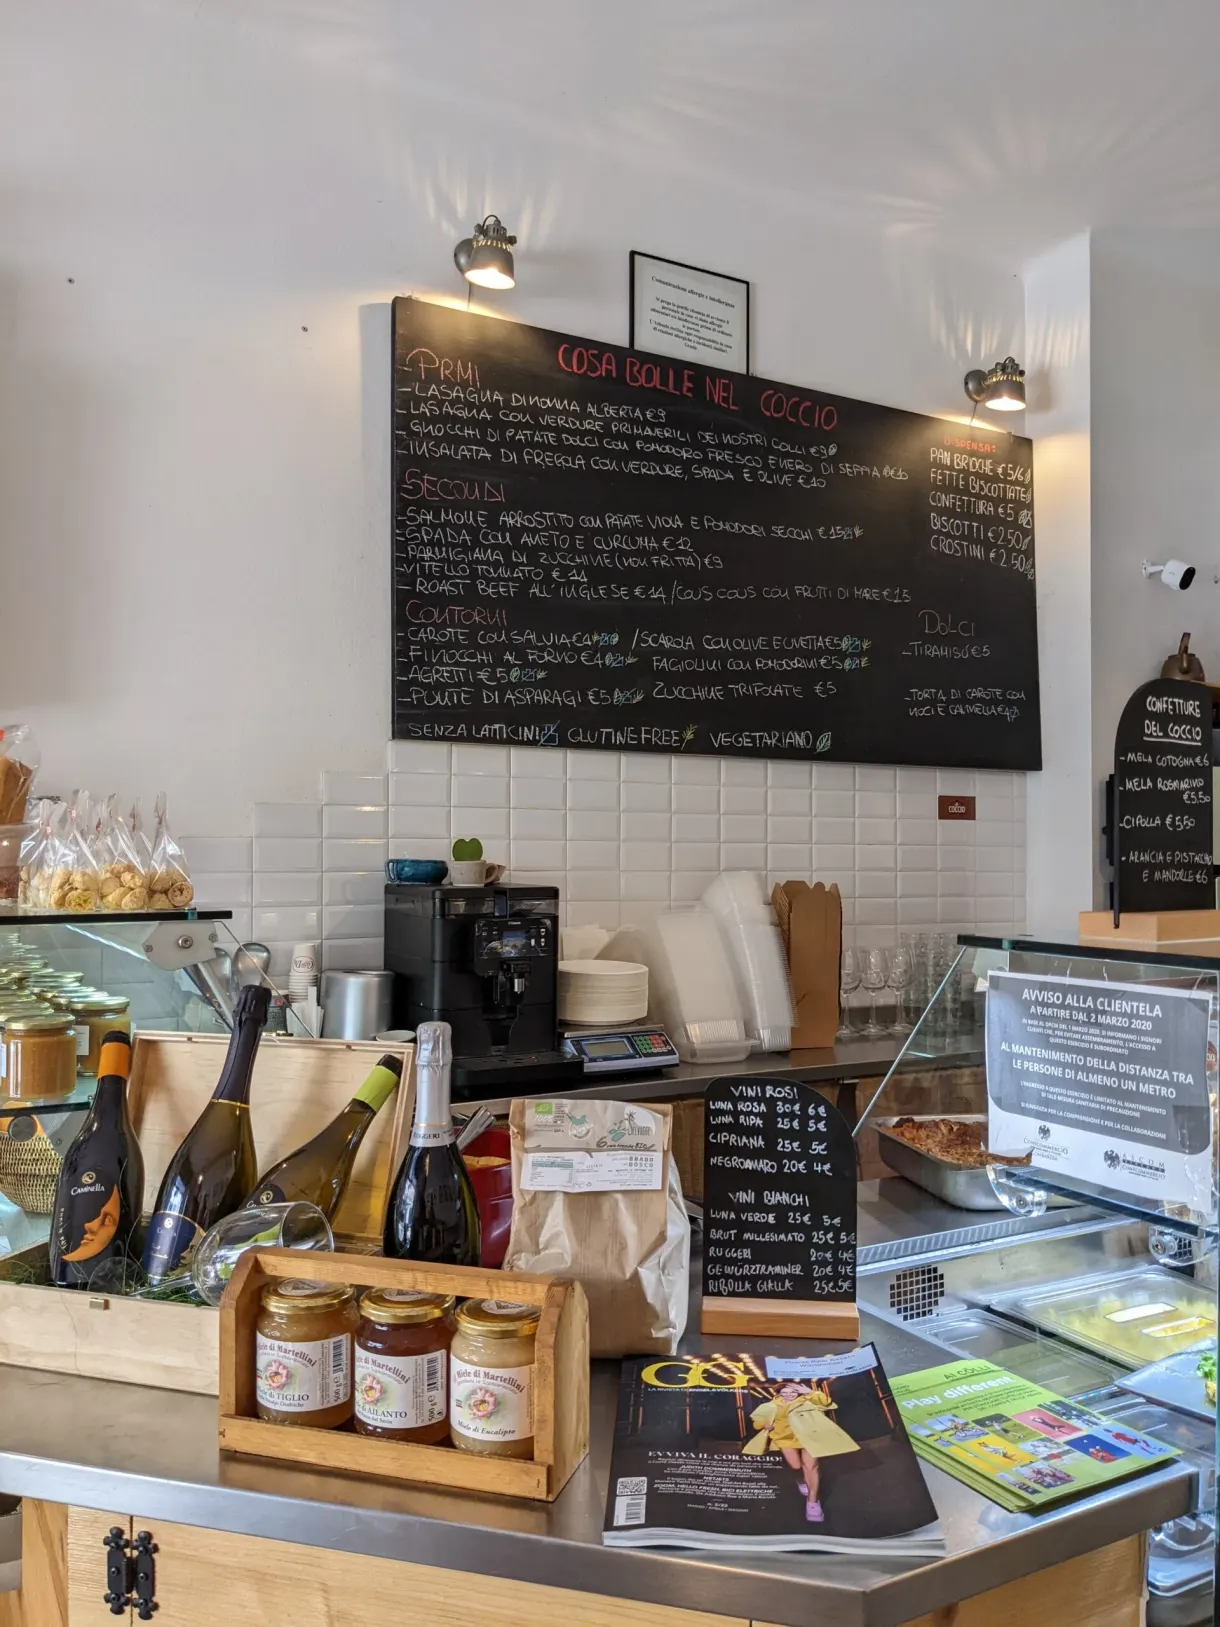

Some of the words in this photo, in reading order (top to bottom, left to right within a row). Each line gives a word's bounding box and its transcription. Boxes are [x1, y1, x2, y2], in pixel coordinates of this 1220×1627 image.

[558, 344, 616, 378] COSA
[626, 358, 694, 397] BOLLE
[706, 379, 739, 410] NEL
[760, 390, 837, 431] COCCIO
[586, 401, 643, 421] ALBERTA
[539, 415, 604, 433] VERDURE
[723, 431, 767, 448] NOSTRI
[771, 438, 805, 456] COLLI
[943, 436, 996, 454] DISPENSA:
[409, 419, 480, 440] GNOCCHI
[506, 429, 557, 447] PATATE
[563, 432, 599, 448] DOLCI
[636, 440, 703, 462] POMODORO
[707, 449, 763, 468] FRESCO
[839, 463, 881, 479] SEPPIA
[410, 441, 492, 462] INSALATA
[691, 464, 735, 482] SPADA
[758, 471, 792, 488] OLIVE
[930, 446, 951, 467] PAN
[953, 454, 994, 477] BRIOCHE
[930, 467, 965, 490] FETTE
[968, 476, 1027, 502] BISCOTTATE
[929, 490, 994, 516] CONFETTURA
[405, 506, 488, 528] SALMONE
[499, 510, 573, 529] ARROSTITO
[605, 513, 643, 530] PATATE
[647, 513, 684, 530] VIOLA
[703, 515, 766, 538] POMODORI
[771, 523, 815, 542] SECCHI
[930, 512, 984, 541] BISCOTTI
[405, 526, 472, 546] SPADA
[520, 530, 570, 549] ANETO
[593, 535, 659, 552] CURCUMA
[930, 535, 984, 561] CROSTINI
[407, 545, 505, 564] PARMIGIANA
[403, 561, 470, 577] VITELLO
[416, 579, 471, 596] ROAST
[477, 579, 520, 598] BEEF
[717, 585, 757, 600] COUS
[794, 584, 832, 600] FRUTTI
[854, 587, 881, 601] MARE
[919, 608, 975, 637] DOLCI
[407, 627, 470, 644] CAROTE
[510, 630, 571, 648] SALVIA
[732, 635, 769, 650] OLIVE
[409, 645, 492, 664] FINOCCHI
[528, 650, 578, 665] FORNO
[409, 666, 475, 684] AGRETTI
[504, 689, 581, 708] ASPARAGI
[728, 684, 804, 699] TRIFOLATE
[909, 688, 946, 701] TORTA
[965, 687, 1003, 700] CAROTE
[1146, 695, 1200, 718] CONFETTURE
[408, 724, 467, 740] SENZA
[472, 725, 541, 744] LATTICINI
[641, 731, 681, 747] FREE
[1144, 719, 1163, 737] DEL
[1168, 723, 1202, 740] COCCIO
[709, 731, 813, 749] VEGETARIANO
[1127, 752, 1153, 764] MELA
[1156, 755, 1195, 767] COTOGNA
[1125, 777, 1153, 791] MELA
[1123, 814, 1161, 829] CIPOLLA
[1129, 849, 1164, 864] ARANCIA
[1022, 987, 1061, 1005] AVVISO
[1065, 993, 1094, 1009] ALLA
[1096, 996, 1163, 1018] CLIENTELA
[1037, 1006, 1070, 1020] PARTIRE
[1072, 1010, 1088, 1022] DAL
[1090, 1013, 1096, 1023] 2
[1097, 1014, 1128, 1028] MARZO
[1131, 1018, 1152, 1031] 2020
[1011, 1042, 1085, 1065] MANTENIMENTO
[1086, 1055, 1116, 1072] DELLA
[1118, 1059, 1169, 1081] DISTANZA
[1171, 1070, 1195, 1085] TRA
[1012, 1058, 1021, 1069] LE
[1023, 1060, 1063, 1078] PERSONE
[1065, 1068, 1075, 1080] DI
[1076, 1071, 1119, 1088] ALMENO
[1120, 1078, 1136, 1091] UN
[1139, 1081, 1177, 1099] METRO
[730, 1085, 761, 1098] VINI
[766, 1085, 798, 1100] ROSI
[709, 1100, 734, 1112] LUNA
[737, 1102, 767, 1113] ROSA
[807, 1104, 827, 1117] 6€
[1106, 1105, 1140, 1119] PRECAUZIONE
[1124, 1100, 1166, 1116] MANTENIMENTO
[709, 1115, 734, 1126] LUNA
[738, 1116, 763, 1128] RIPA
[776, 1118, 800, 1130] 25€
[807, 1119, 827, 1132] 5€
[1121, 1123, 1166, 1140] COLLABORAZIONE
[708, 1132, 765, 1149] CIPRIANA
[776, 1139, 801, 1152] 25€
[808, 1142, 828, 1155] 5€
[709, 1155, 777, 1174] NEGROAMARO
[782, 1159, 807, 1174] 20€
[812, 1159, 833, 1176] 4€
[728, 1190, 755, 1205] VINI
[763, 1190, 810, 1207] BIANCHI
[709, 1208, 736, 1221] LUNA
[740, 1212, 777, 1224] VERDE
[787, 1212, 812, 1225] 25€
[822, 1214, 842, 1227] 5€
[709, 1229, 737, 1241] BRUT
[742, 1231, 805, 1243] MILLESIMATO
[811, 1231, 835, 1244] 25€
[708, 1247, 752, 1260] RUGGERI
[809, 1248, 833, 1262] 20€
[707, 1261, 804, 1276] GEWÜRZTRAMINER
[812, 1264, 834, 1277] 20€
[707, 1278, 752, 1296] RIBOLLA
[276, 1342, 318, 1368] Martellini
[371, 1358, 411, 1385] Martellini
[483, 1370, 526, 1394] Martellini
[276, 1391, 310, 1402] TIGLIO
[901, 1393, 942, 1410] Play
[943, 1375, 1017, 1400] different
[367, 1406, 408, 1419] AILANTO
[480, 1426, 517, 1438] Eucalipto
[647, 1450, 697, 1459] EVVIVA
[713, 1453, 783, 1463] CORAGGIO!
